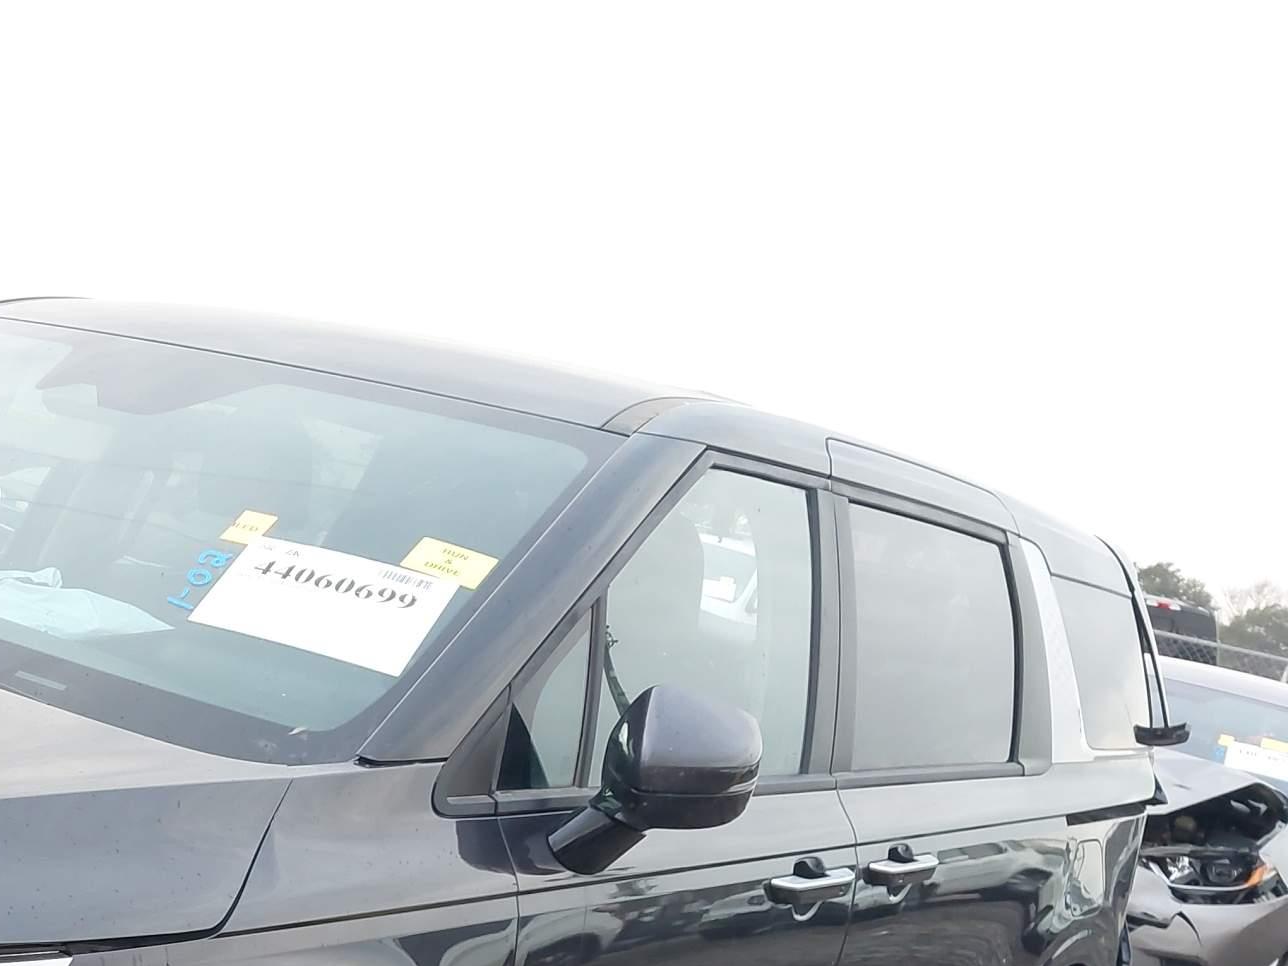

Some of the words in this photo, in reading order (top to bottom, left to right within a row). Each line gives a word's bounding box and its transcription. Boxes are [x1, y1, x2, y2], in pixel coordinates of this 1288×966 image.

[442, 547, 470, 560] RUN
[423, 560, 462, 577] DRIVE
[253, 560, 418, 609] 44060699
